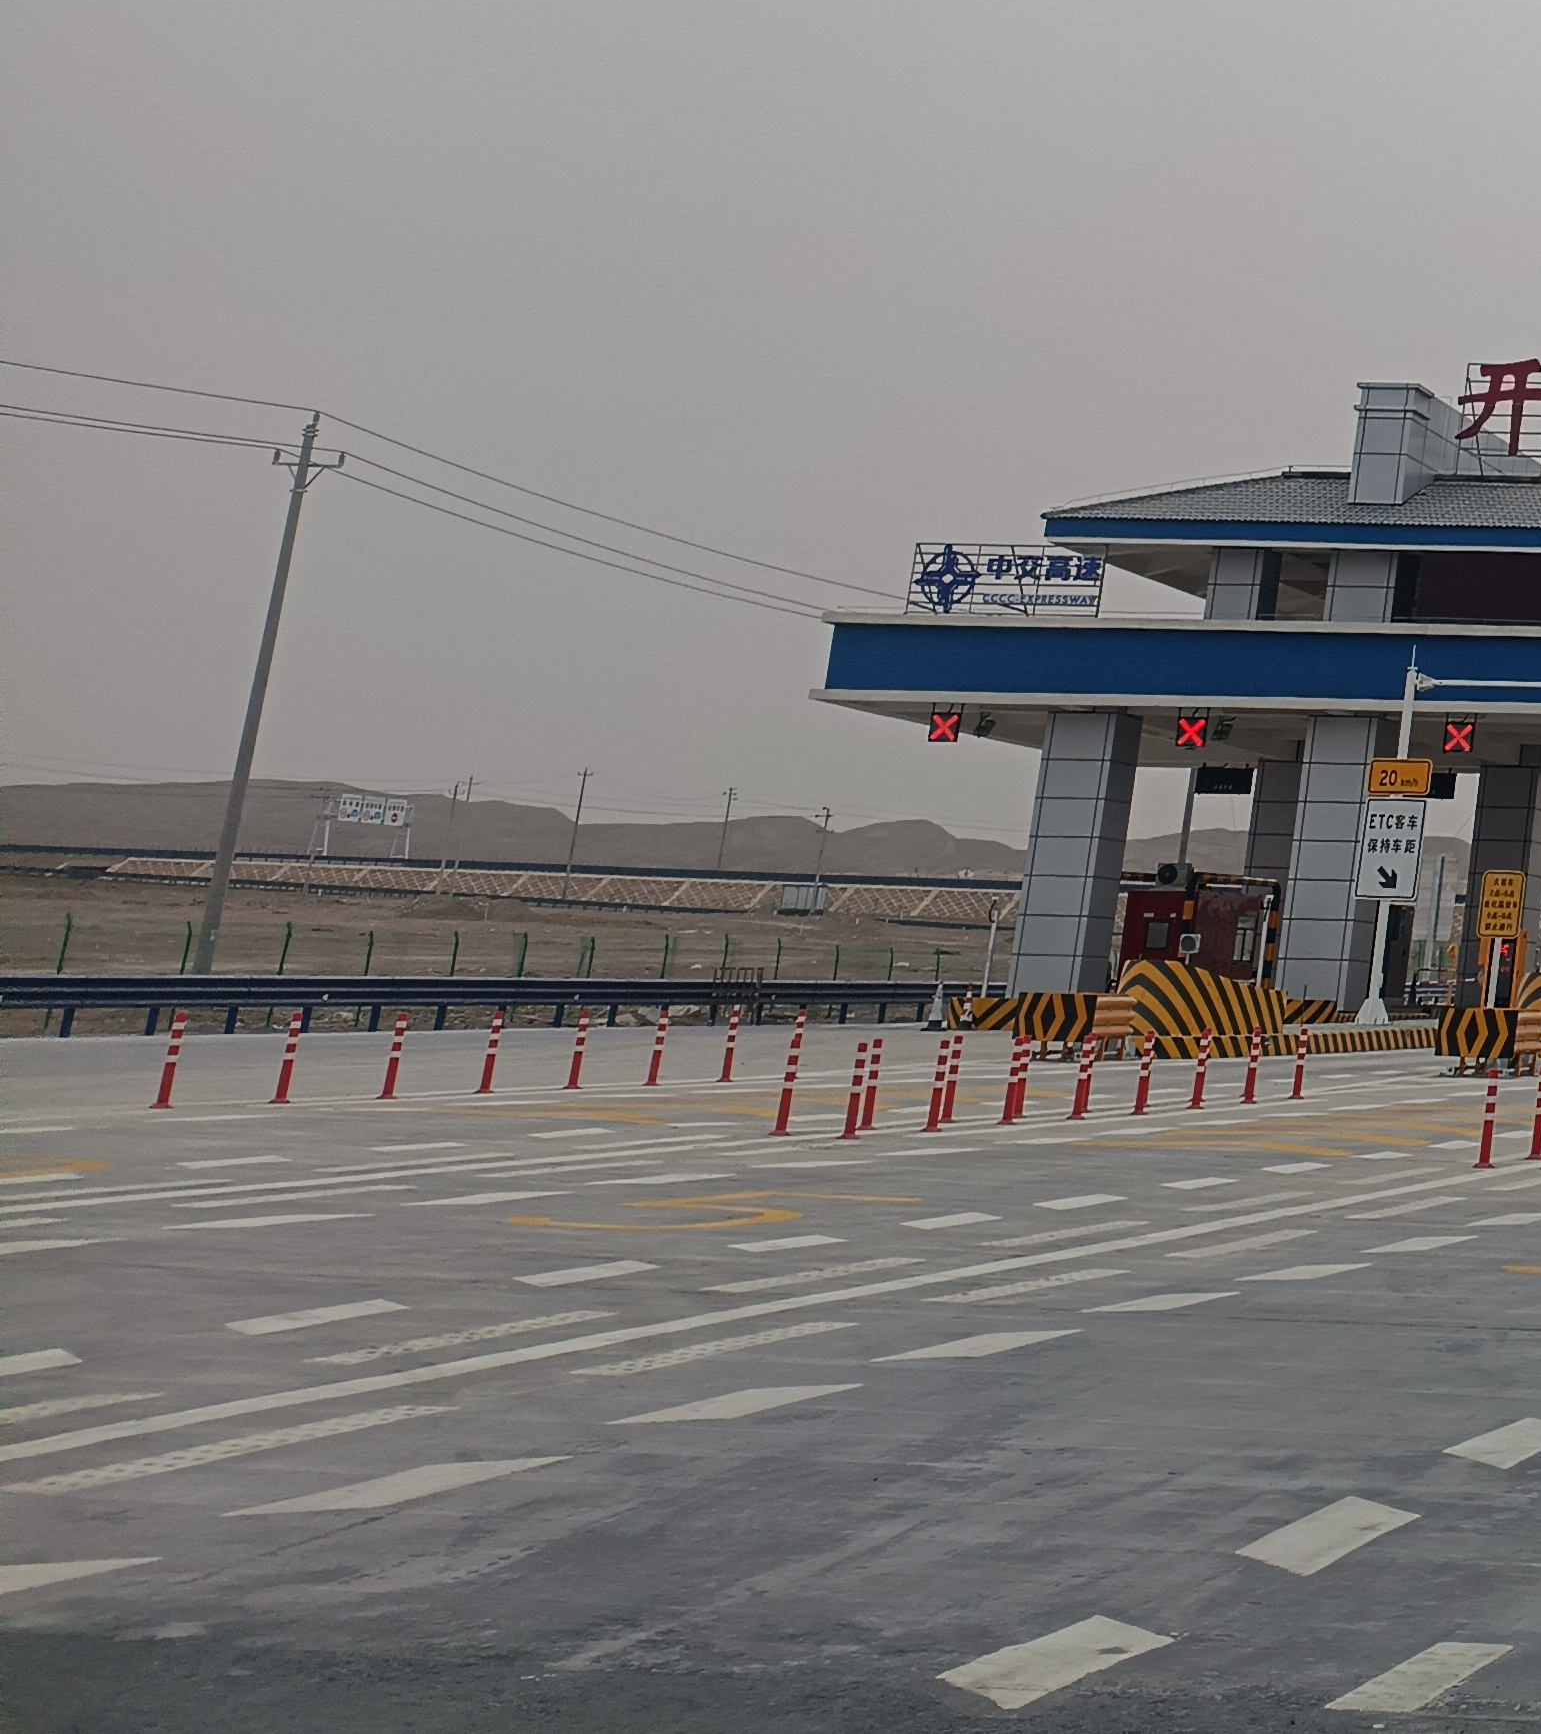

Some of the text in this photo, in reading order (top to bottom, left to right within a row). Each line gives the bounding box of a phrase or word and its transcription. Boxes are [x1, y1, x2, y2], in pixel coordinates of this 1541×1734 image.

[987, 555, 1102, 582] 中交高速
[1379, 770, 1419, 787] 20 km/h
[1369, 814, 1418, 830] ETC客车
[1367, 838, 1417, 854] 保持车距
